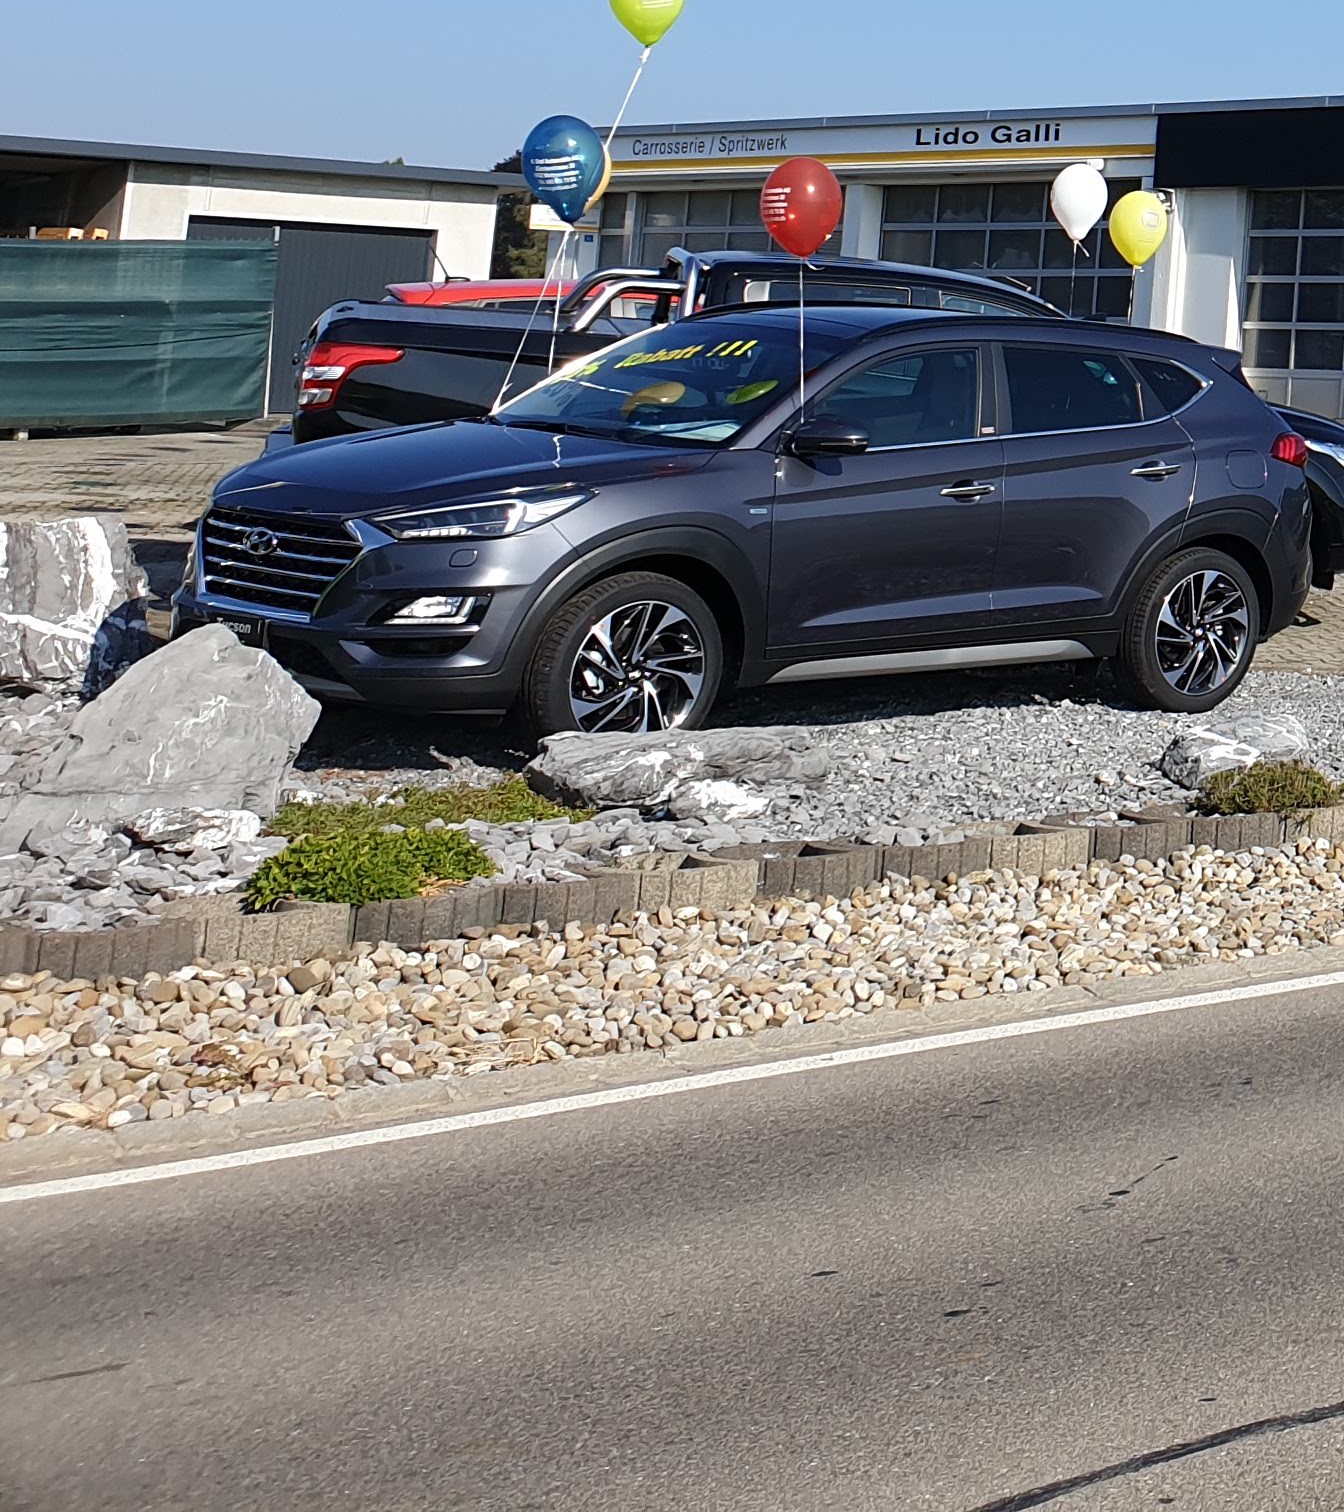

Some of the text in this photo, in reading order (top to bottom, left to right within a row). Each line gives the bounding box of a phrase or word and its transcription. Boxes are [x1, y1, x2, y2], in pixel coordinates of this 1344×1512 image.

[632, 137, 706, 156] Carrosserie
[718, 134, 788, 156] Spritzwerk
[915, 123, 1061, 146] Lido Galli
